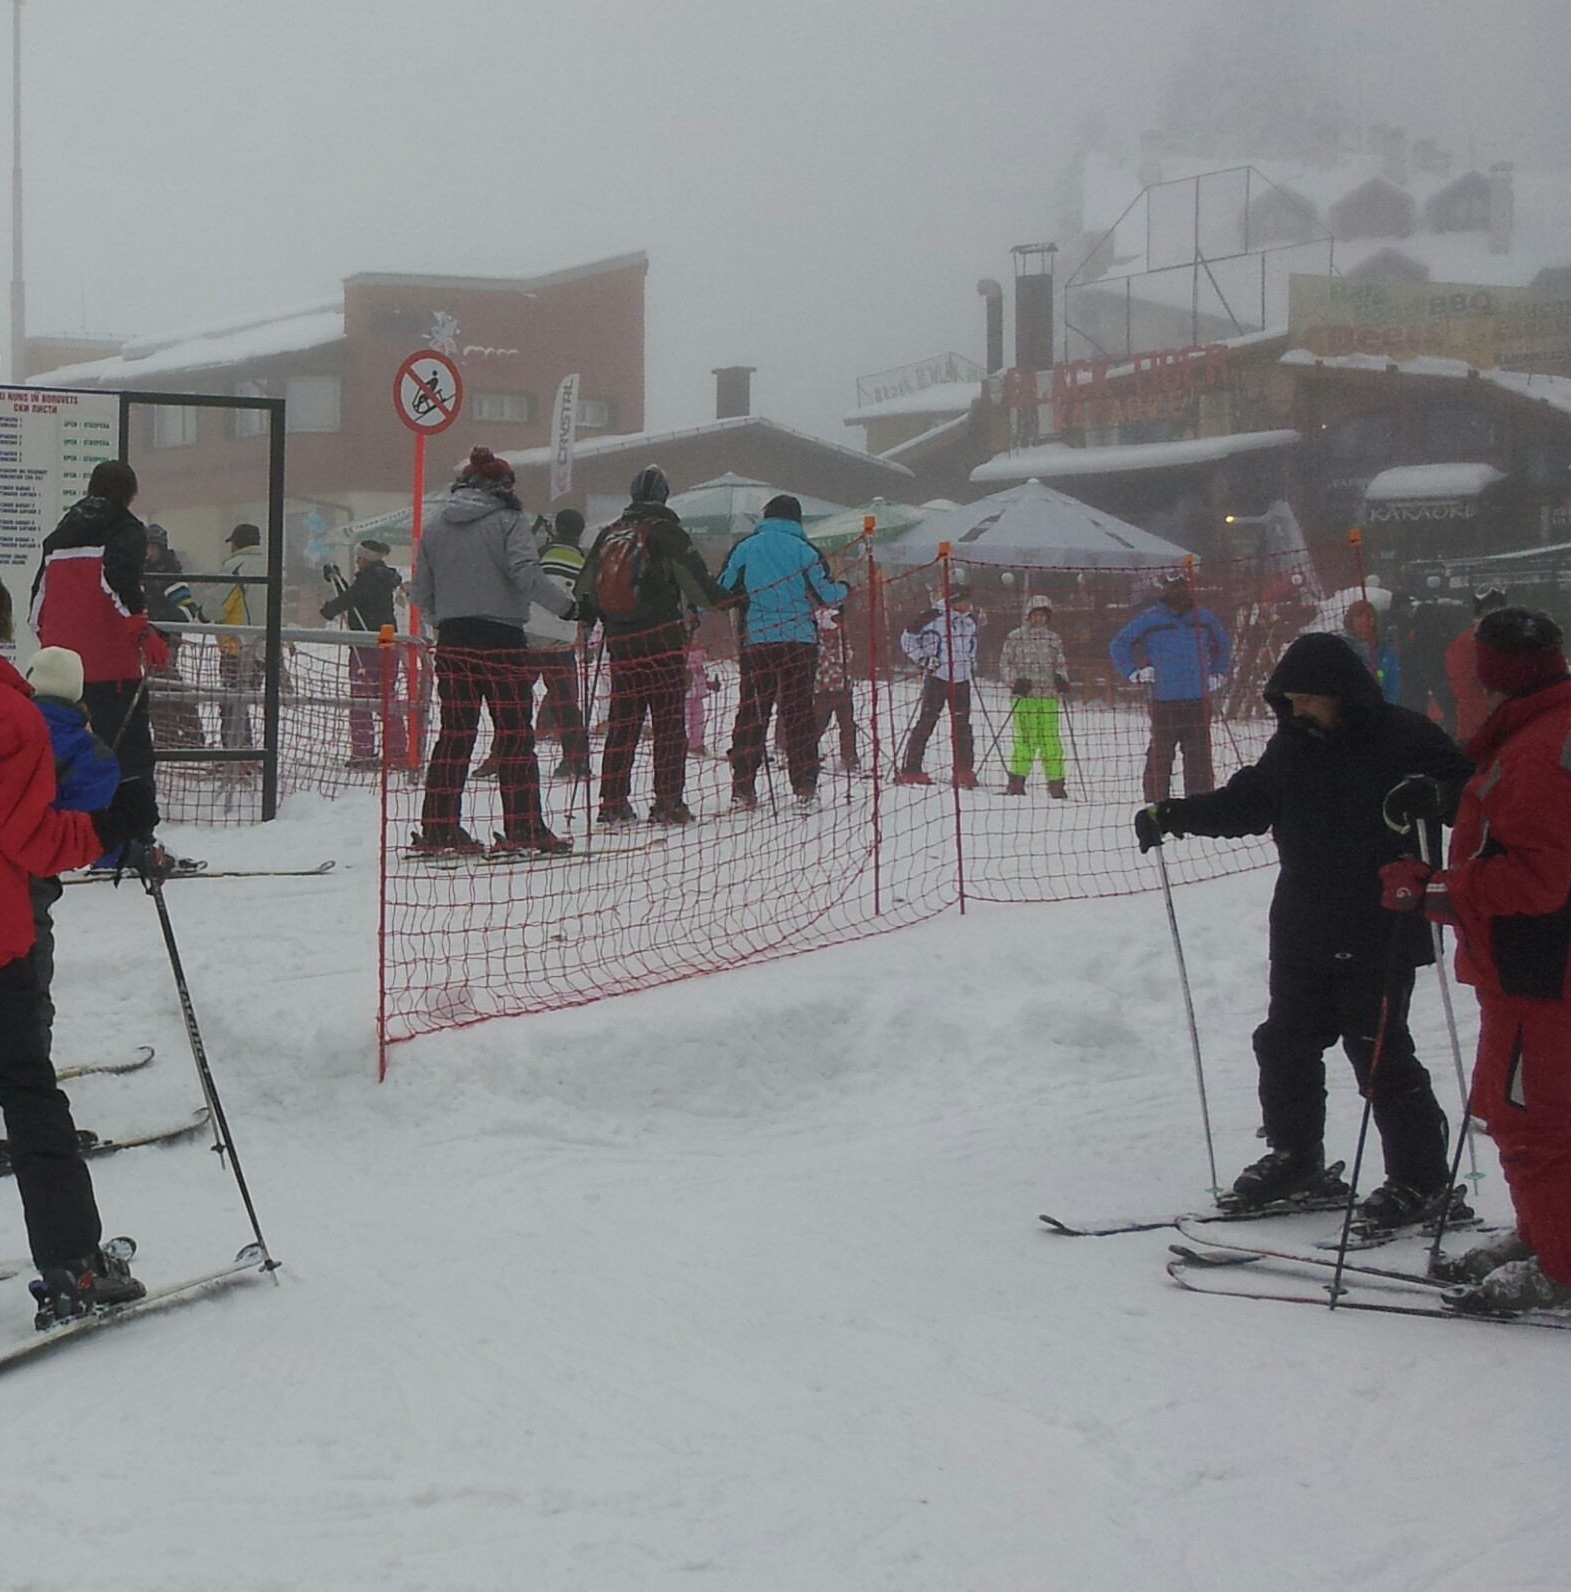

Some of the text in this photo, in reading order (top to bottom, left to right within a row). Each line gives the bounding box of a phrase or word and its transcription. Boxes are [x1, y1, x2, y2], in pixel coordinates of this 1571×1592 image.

[1427, 292, 1494, 317] BBQ
[7, 392, 29, 402] RUNS
[30, 393, 40, 402] IN
[41, 393, 79, 405] BOROVETS
[557, 378, 574, 466] CRYSTAL
